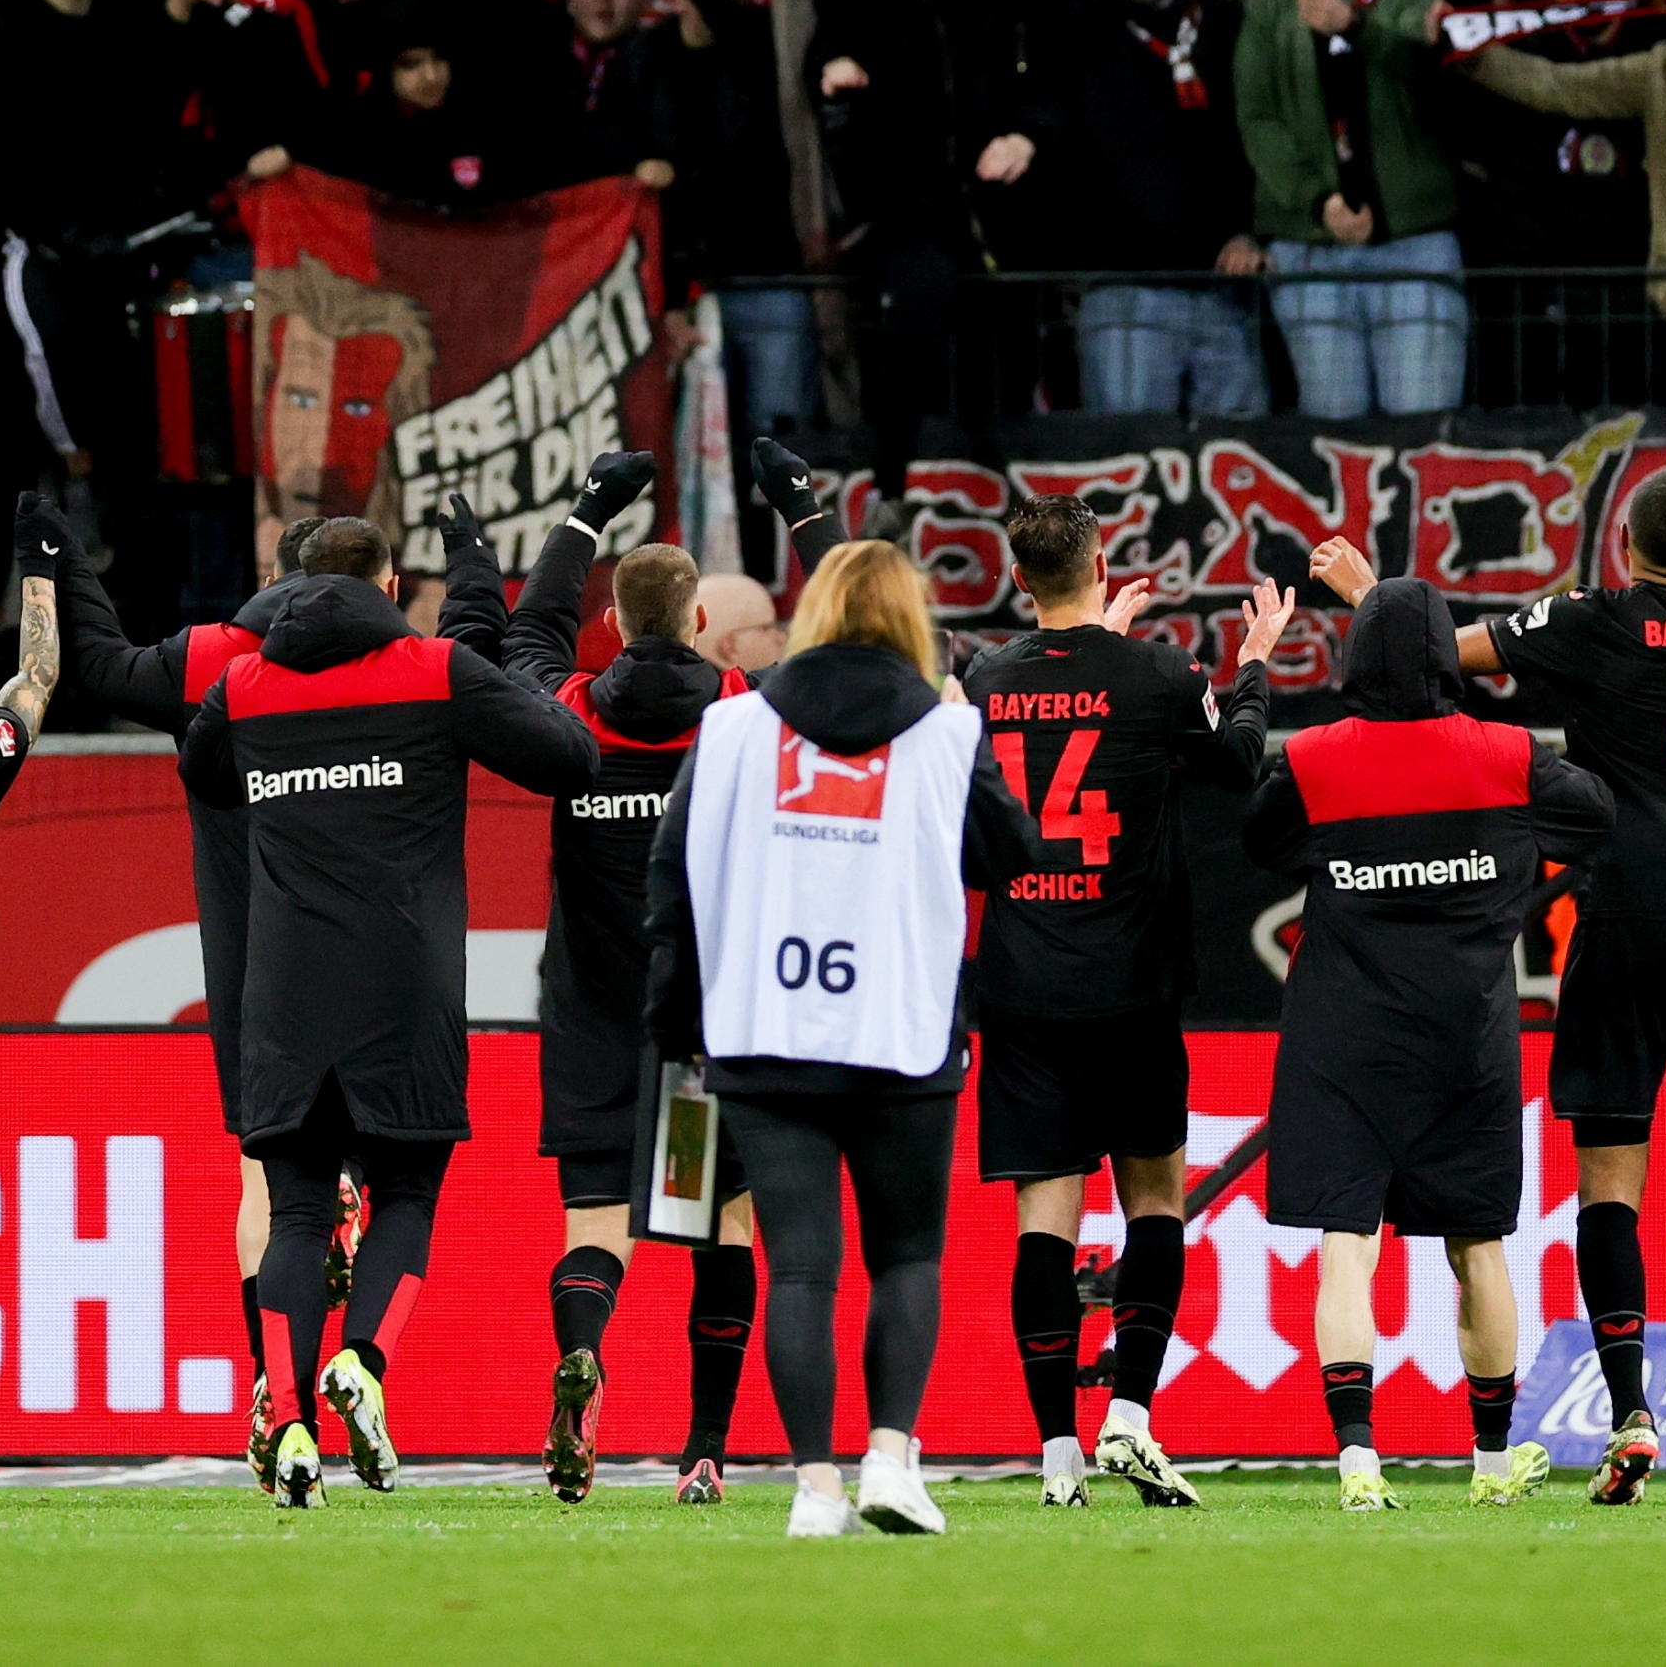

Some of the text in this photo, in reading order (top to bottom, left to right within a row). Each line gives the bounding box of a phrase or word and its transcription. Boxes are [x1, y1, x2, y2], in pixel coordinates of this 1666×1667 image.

[531, 384, 623, 505] DIE
[247, 755, 403, 804] Barmenia
[992, 730, 1121, 866] 14
[773, 821, 881, 846] BUNDESLIGA
[1010, 873, 1102, 901] SCHICK
[1329, 850, 1497, 891] Barmenia
[777, 936, 856, 994] 06
